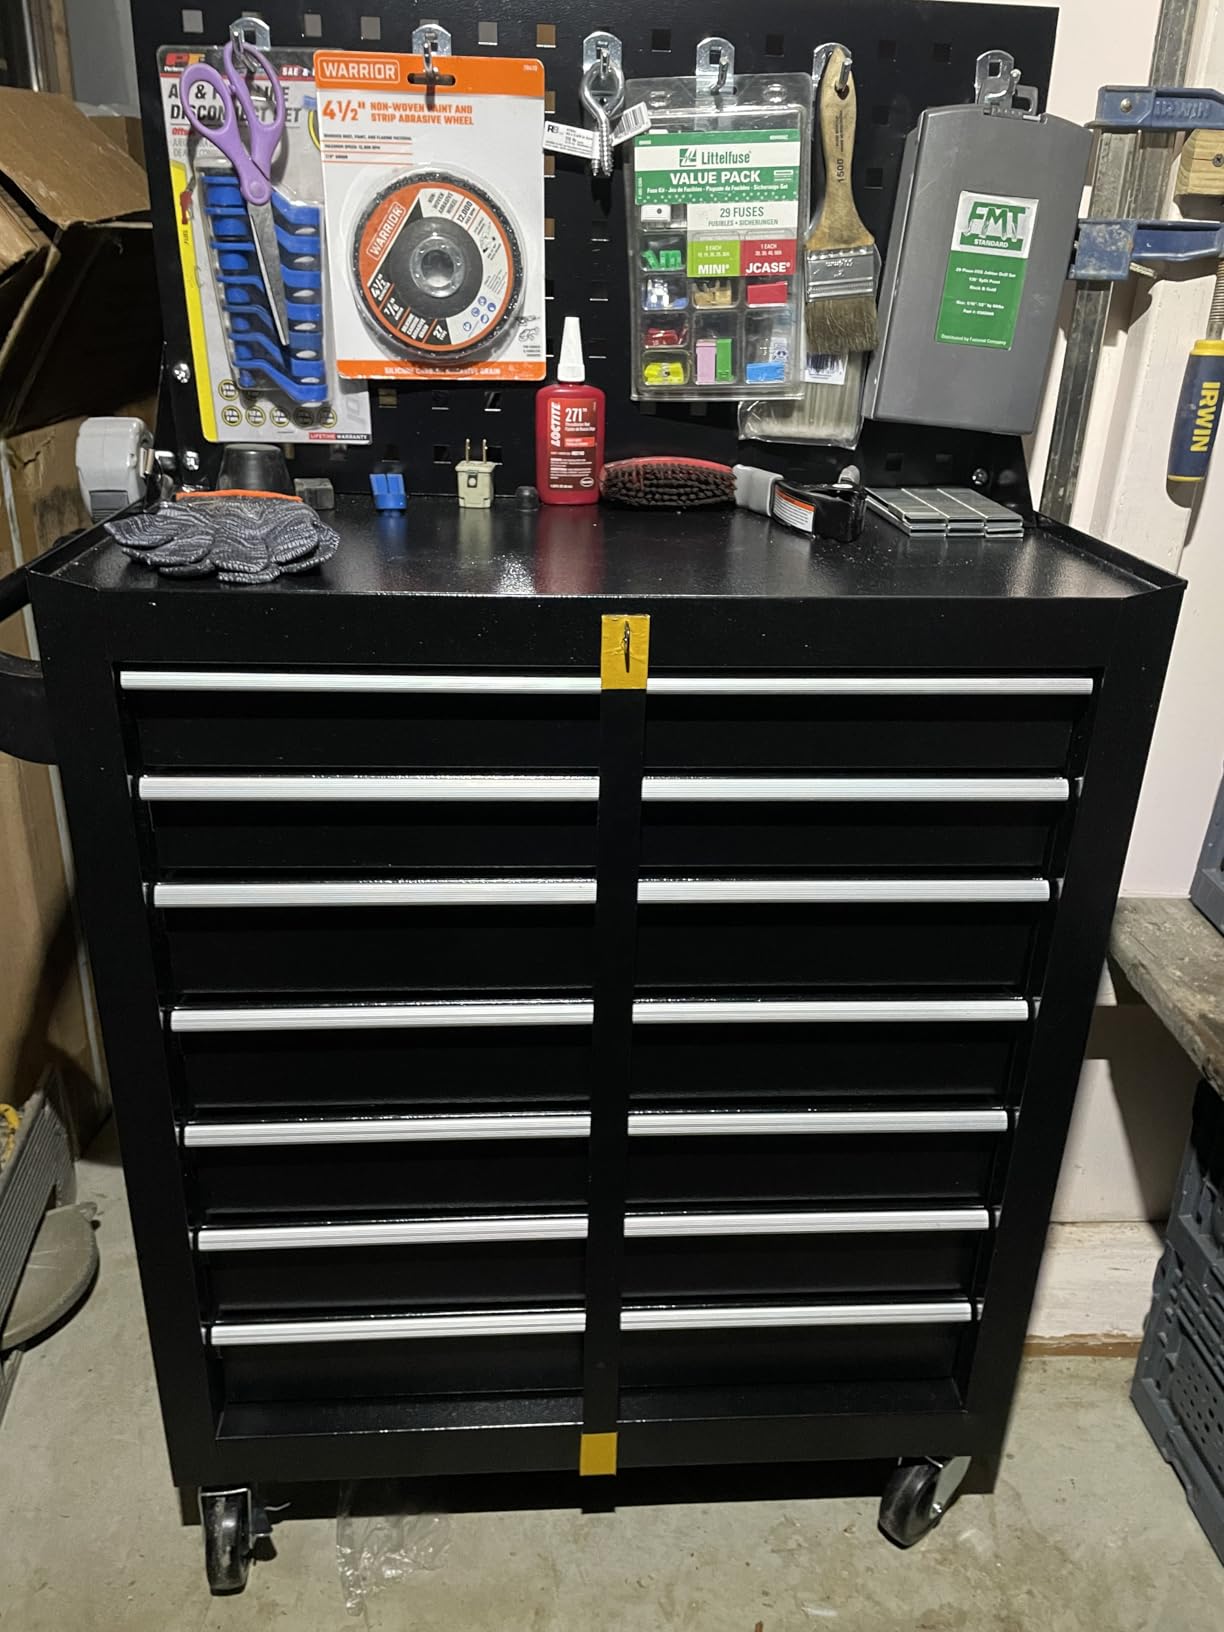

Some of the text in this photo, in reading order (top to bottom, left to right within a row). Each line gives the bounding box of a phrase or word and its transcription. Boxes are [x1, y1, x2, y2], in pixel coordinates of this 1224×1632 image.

[282, 67, 298, 76] SAE
[322, 62, 396, 80] WARRIOR
[195, 84, 206, 99] &
[370, 102, 424, 113] NON-WOVEN
[455, 104, 472, 114] AND
[371, 112, 474, 125] STRIP ABRASIVE WHEEL
[702, 150, 750, 165] Littelfuse
[836, 158, 844, 182] 1500
[670, 172, 717, 185] VALUE
[721, 170, 760, 183] PACK
[720, 206, 764, 218] 29 FUSES
[370, 205, 404, 257] WARRIOR
[974, 238, 1008, 248] STANDARD
[746, 262, 786, 273] JCASE
[433, 324, 443, 338] 27
[565, 408, 582, 422] 271
[1190, 382, 1220, 452] IRWIN
[550, 401, 561, 447] LOCTITE
